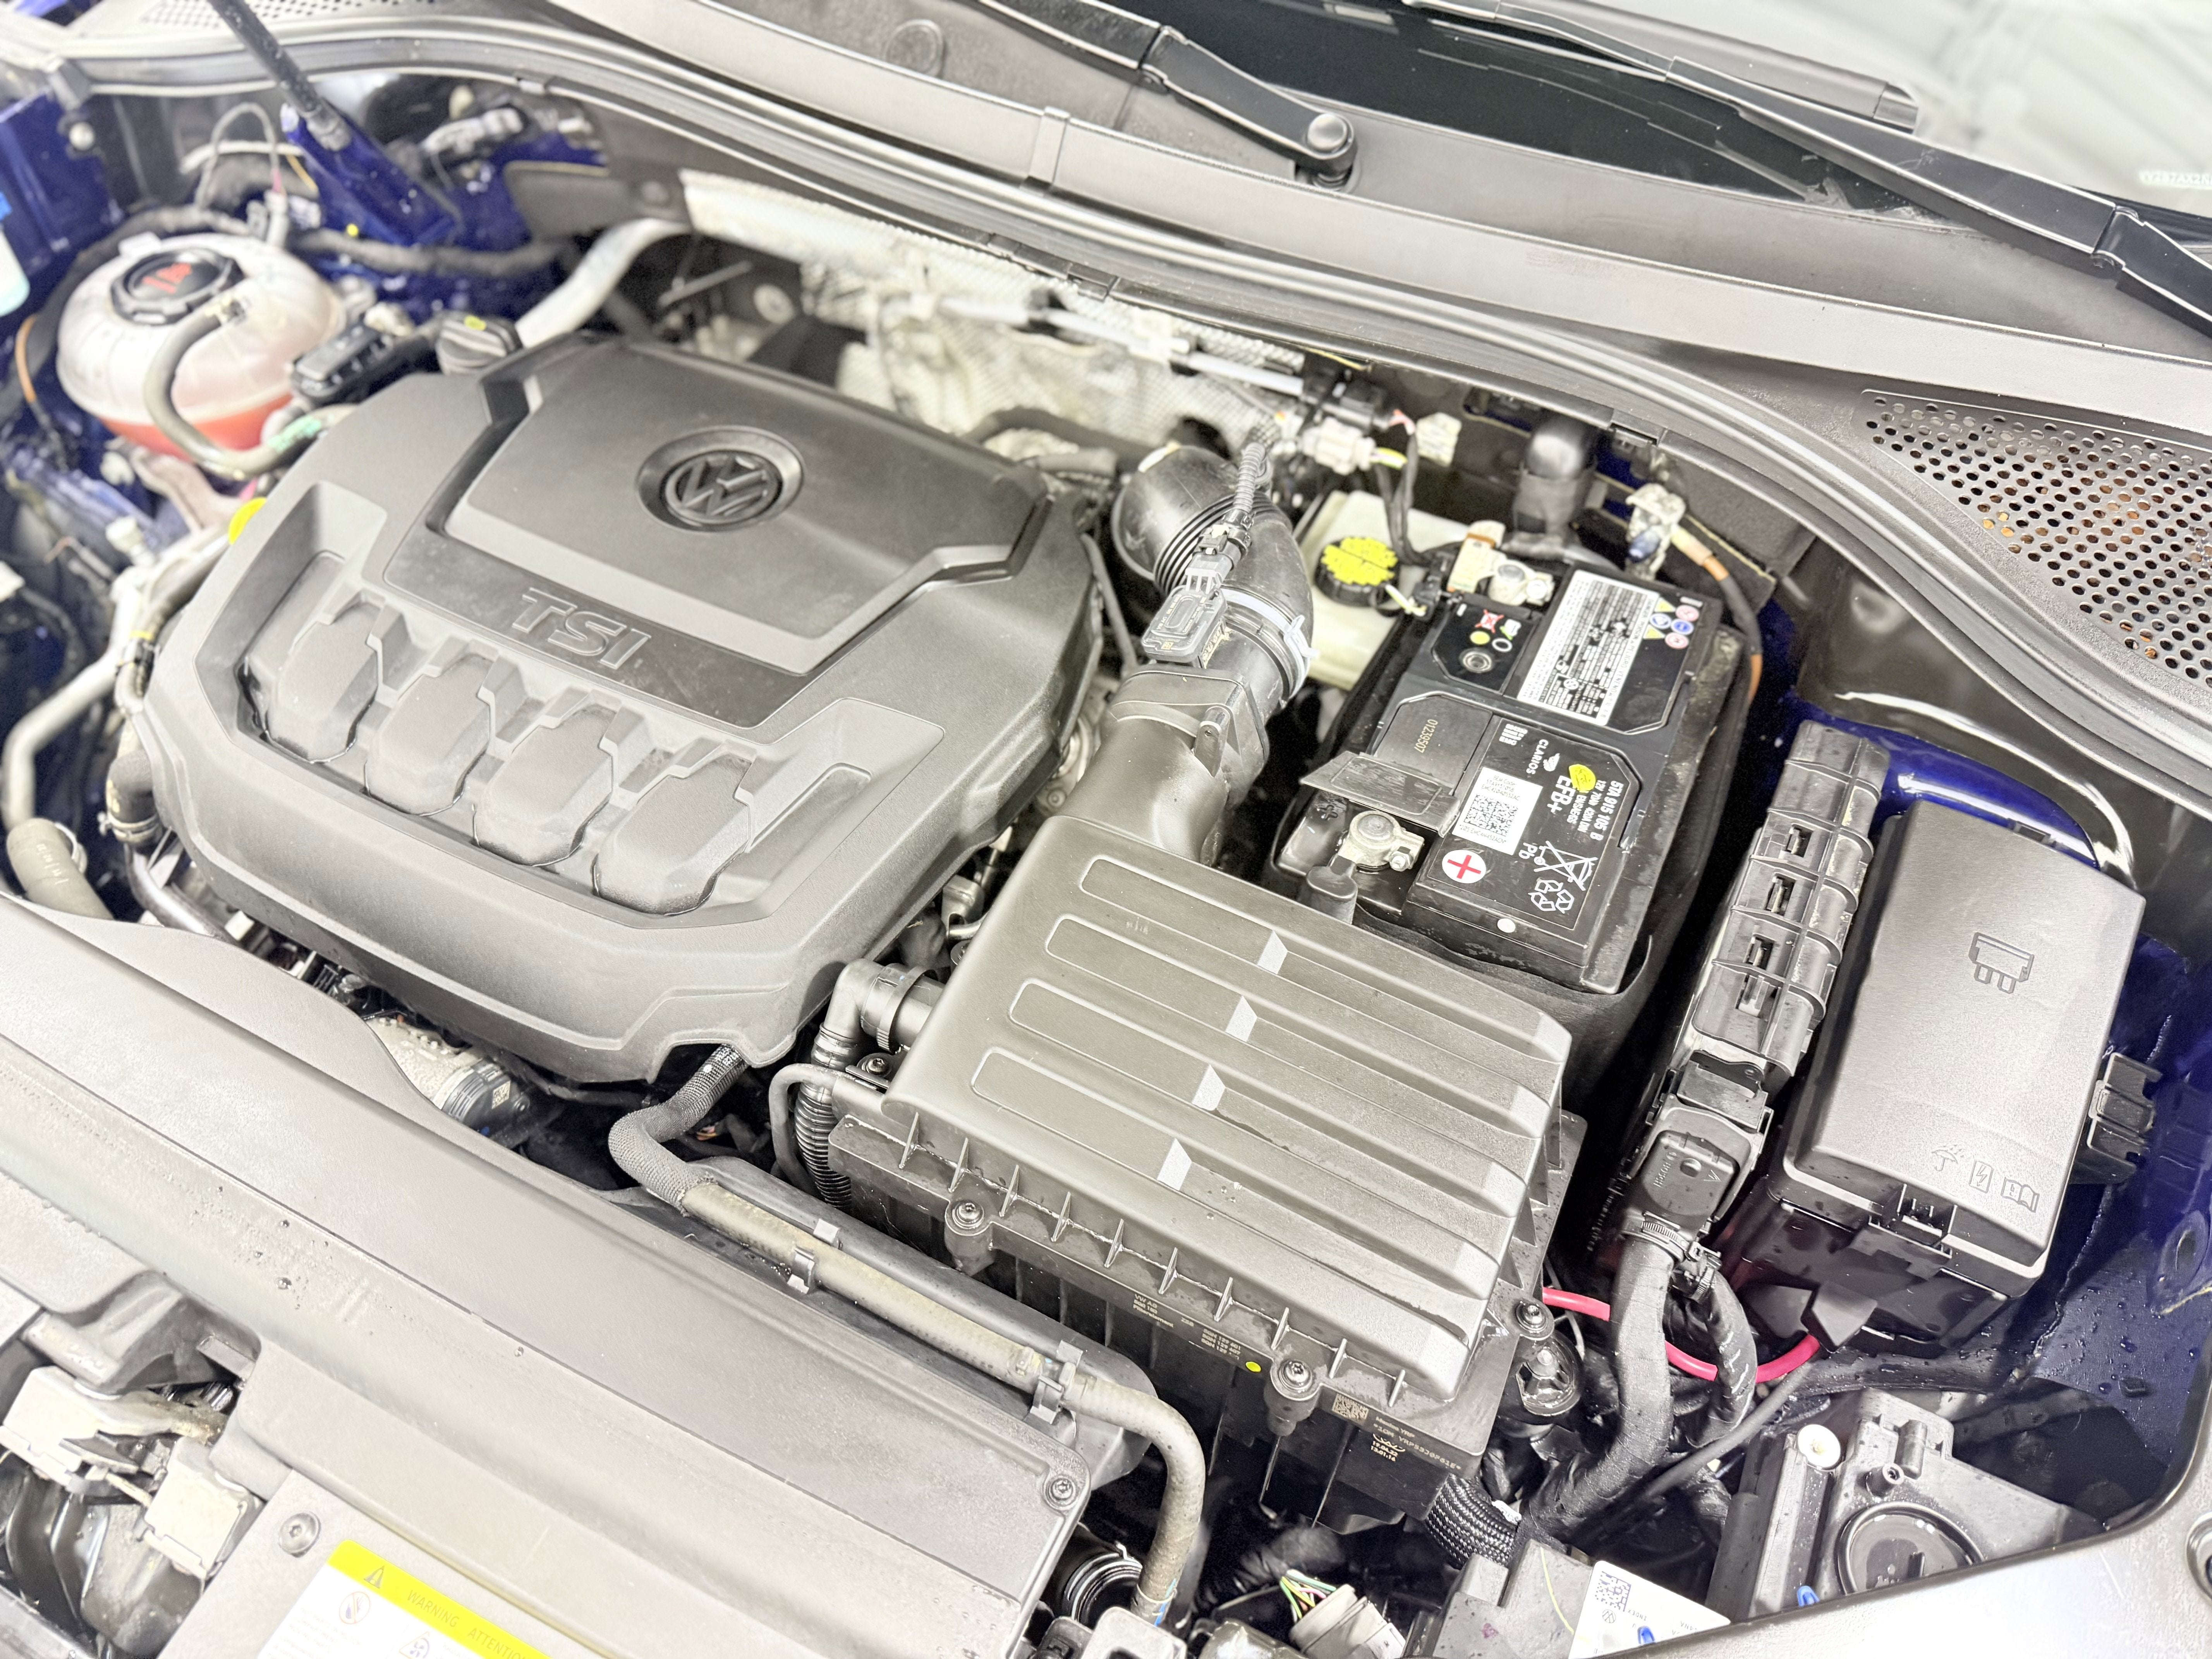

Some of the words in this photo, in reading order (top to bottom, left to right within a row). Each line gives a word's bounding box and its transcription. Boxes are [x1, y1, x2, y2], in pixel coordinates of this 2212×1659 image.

[512, 587, 651, 669] TSI
[1414, 719, 1438, 753] 01239507
[1525, 738, 1549, 775] CLARIOS
[1546, 775, 1576, 813] EFB+
[1594, 780, 1606, 791] 12V
[1606, 780, 1624, 797] 5TA
[1588, 792, 1602, 806] 70Ah
[1600, 796, 1618, 814] 915
[1581, 806, 1595, 822] 420A
[1593, 814, 1610, 831] 105
[1577, 821, 1590, 833] DIN
[1589, 831, 1604, 841] B
[1517, 842, 1537, 860] Pb
[1653, 1162, 1671, 1187] BOSCH
[1135, 1294, 1146, 1303] VW
[1147, 1300, 1158, 1309] AG
[1627, 1608, 1647, 1621] INDEX
[407, 1589, 460, 1628] WARNING
[467, 1627, 529, 1659] ATTENTIO
